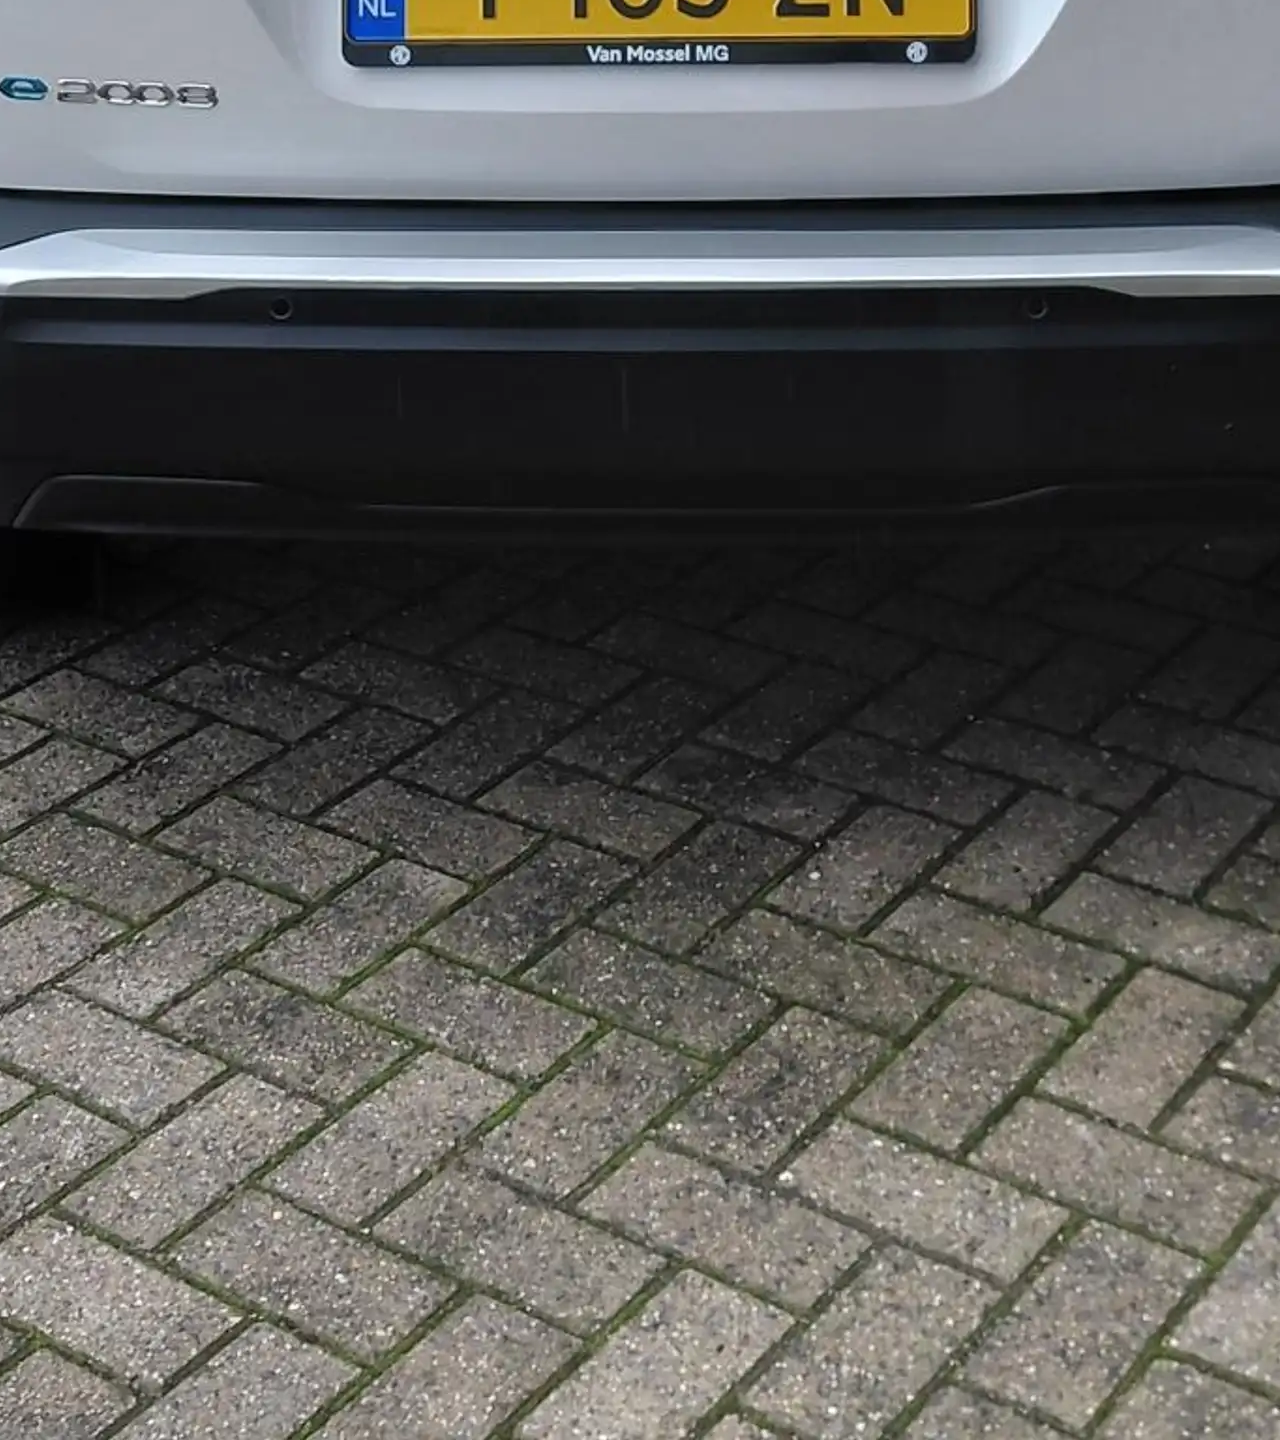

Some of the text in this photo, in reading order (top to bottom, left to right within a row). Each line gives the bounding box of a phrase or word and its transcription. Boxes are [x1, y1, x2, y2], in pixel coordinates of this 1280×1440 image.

[586, 43, 729, 62] Van Mossel MG
